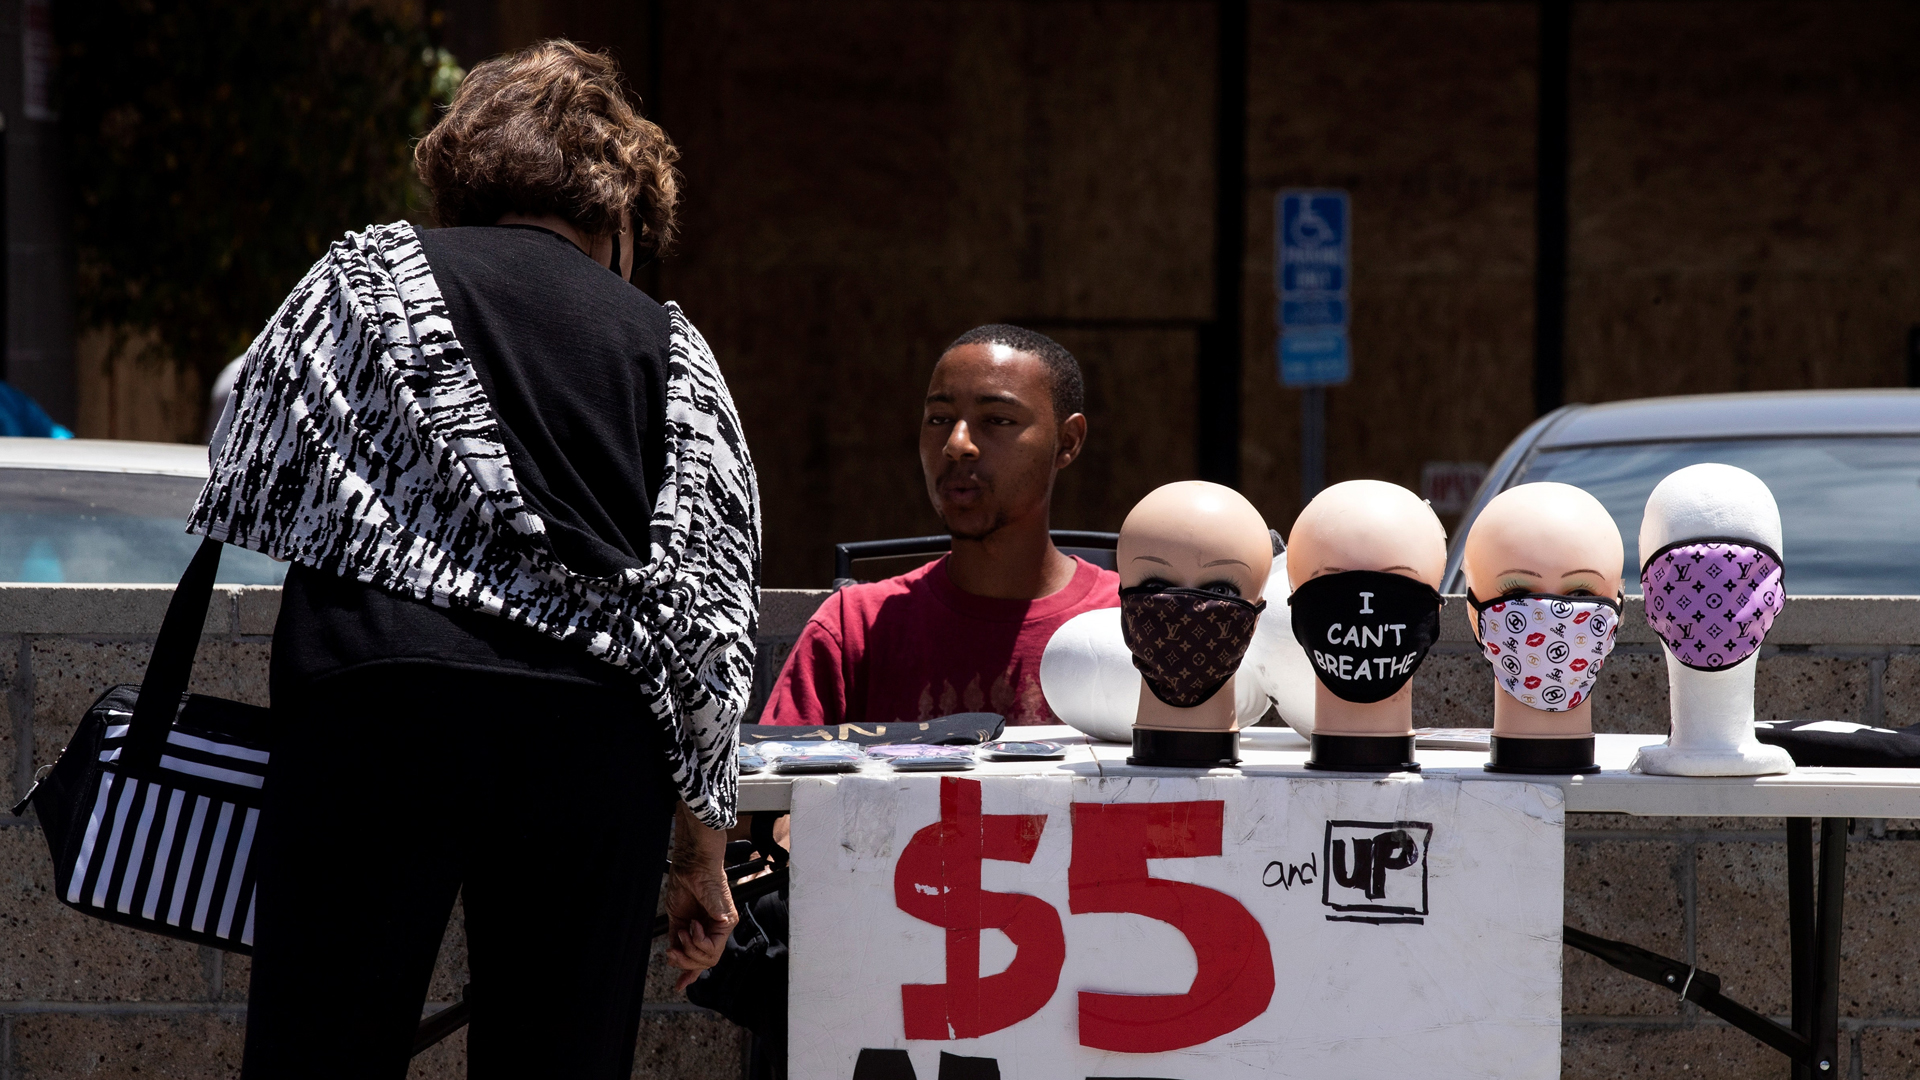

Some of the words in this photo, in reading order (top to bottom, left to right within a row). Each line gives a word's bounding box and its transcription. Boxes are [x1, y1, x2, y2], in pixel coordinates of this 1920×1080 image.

[1359, 592, 1374, 614] I
[1327, 623, 1406, 649] CAN'T
[1313, 650, 1417, 681] BREATHE
[894, 776, 1275, 1053] $5
[1262, 852, 1317, 890] and
[1333, 830, 1419, 901] UP
